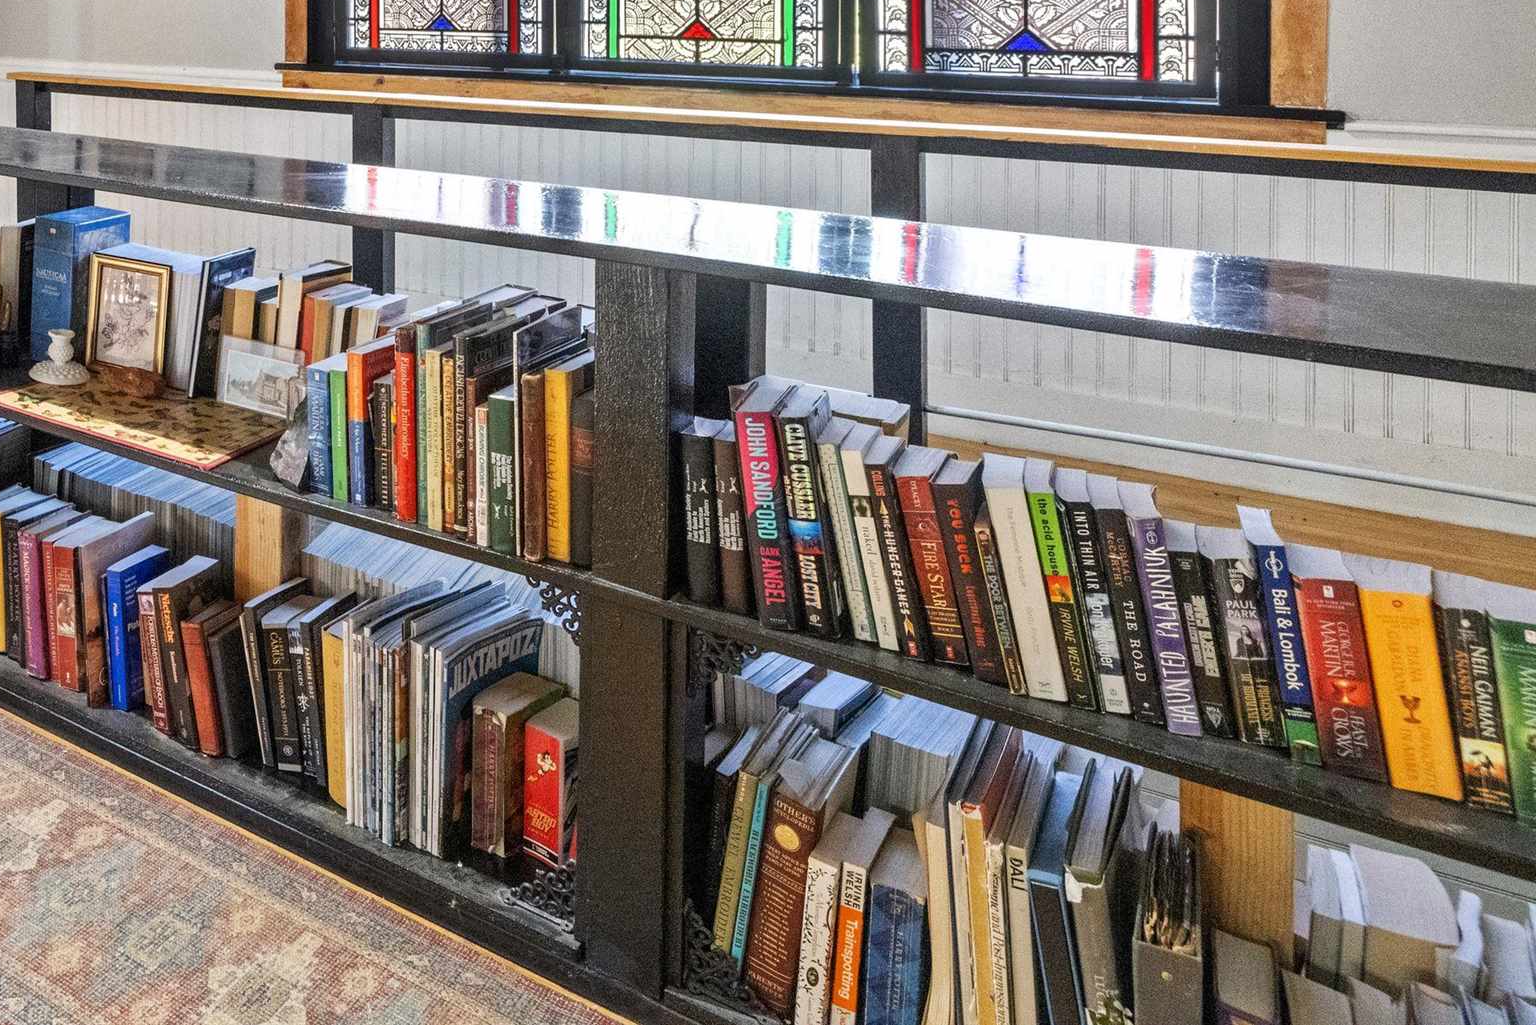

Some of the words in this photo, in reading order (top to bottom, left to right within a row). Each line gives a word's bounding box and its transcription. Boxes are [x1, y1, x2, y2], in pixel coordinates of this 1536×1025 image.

[400, 357, 410, 409] Elizabethan
[400, 411, 411, 460] Embroidery
[745, 418, 768, 457] JOHN
[784, 423, 808, 462] CLIVE
[546, 433, 559, 480] POTTER
[750, 461, 778, 539] SANDFORD
[790, 464, 816, 519] CUSSLER
[871, 470, 886, 496] COLLINS
[547, 489, 559, 530] HARRY
[880, 514, 890, 526] THE
[1037, 497, 1047, 516] the
[1073, 511, 1088, 537] INTO
[862, 526, 877, 556] naked
[946, 499, 962, 528] YOU
[954, 534, 973, 574] SUCK
[1042, 519, 1054, 542] acid
[22, 550, 31, 582] MAGICK
[760, 546, 780, 556] DARK
[798, 555, 818, 582] LOST
[884, 530, 902, 577] HUNGER
[920, 542, 939, 568] FIRE
[983, 555, 996, 574] THE
[1046, 544, 1058, 576] house
[1079, 541, 1096, 566] THIN
[1116, 537, 1133, 583] CORMAC
[762, 557, 786, 608] ANGEL
[803, 583, 822, 610] CITY
[894, 580, 910, 615] GAMES
[927, 572, 947, 608] STAR
[989, 575, 1002, 602] DOOR
[1085, 570, 1100, 590] AIR
[1144, 547, 1180, 639] PALAHNIUK
[160, 593, 174, 644] Nietzsche
[1122, 600, 1138, 632] THE
[1226, 599, 1257, 609] PAUL
[1227, 609, 1258, 619] PARK
[1271, 588, 1291, 616] Bali
[995, 603, 1013, 649] BETWEEN
[1059, 608, 1075, 643] IRVINE
[1276, 620, 1292, 633] &
[269, 632, 281, 665] CAMUS
[449, 627, 536, 698] JUXTAPOZ
[1065, 644, 1083, 683] WELSH
[1129, 639, 1147, 682] ROAD
[1280, 634, 1301, 691] Lombok
[1320, 620, 1343, 678] MARTIN
[1470, 645, 1490, 676] NEIL
[295, 658, 304, 687] TOLKIEN
[1160, 652, 1200, 724] HAUNTED
[1455, 649, 1473, 694] ANANSI
[155, 687, 165, 708] ENOCH
[1460, 697, 1475, 728] BOYS
[1474, 680, 1498, 738] GAIMAN
[1519, 664, 1536, 727] MARTIN
[1331, 707, 1352, 757] CROWS
[1351, 712, 1368, 749] FEAST
[527, 807, 557, 828] ASTRO
[532, 818, 552, 834] BOY
[775, 799, 816, 826] OTHER'S
[731, 806, 744, 857] CREWEL
[845, 870, 854, 907] WELSH
[855, 870, 864, 910] IRVINE
[715, 867, 736, 947] EMBROIDER
[838, 919, 858, 1001] Trainspotting
